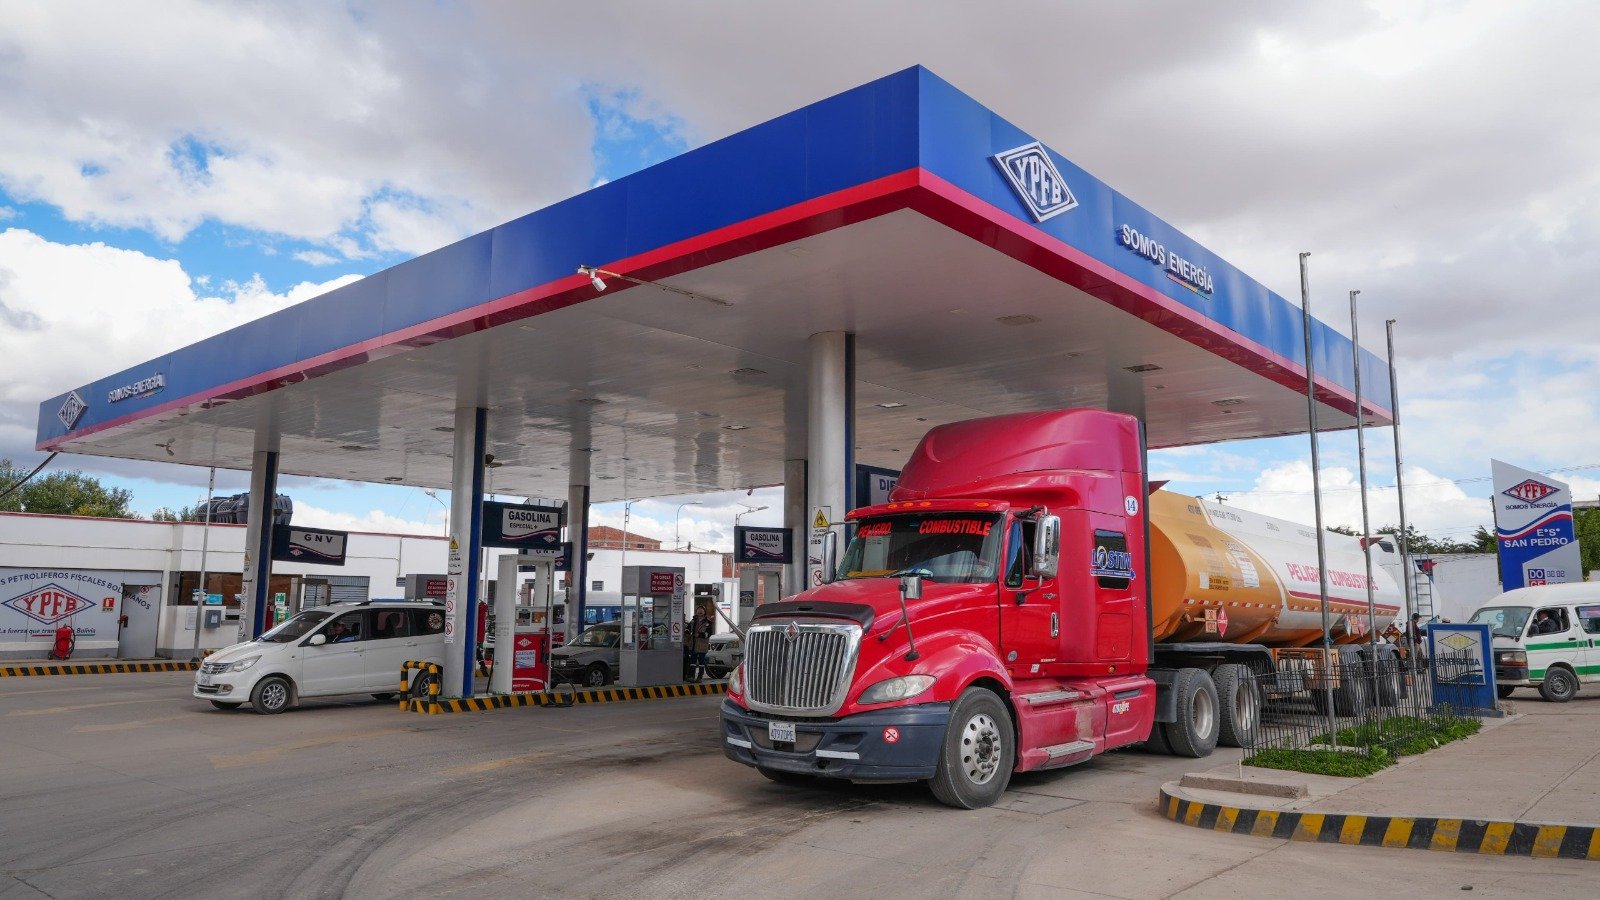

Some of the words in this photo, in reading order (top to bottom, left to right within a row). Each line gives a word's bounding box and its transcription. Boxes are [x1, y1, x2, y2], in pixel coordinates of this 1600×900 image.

[1015, 155, 1062, 206] YPFB
[1121, 224, 1166, 265] SOMOS
[1169, 250, 1214, 294] ENERGÍA
[1515, 483, 1548, 499] YPFB
[1127, 499, 1136, 511] 14
[1530, 501, 1558, 509] ENERGÍA
[508, 510, 551, 523] GASOLINA
[919, 520, 992, 536] COMBUSTIBLE
[750, 533, 780, 542] GASOLINA
[1504, 539, 1528, 548] SAN
[1530, 537, 1569, 547] PEDRO
[8, 572, 69, 584] PETROLIFEROS
[70, 573, 106, 588] FISCALES
[1286, 562, 1321, 583] PELIGR
[1530, 570, 1543, 579] DO
[22, 591, 77, 617] YPFB
